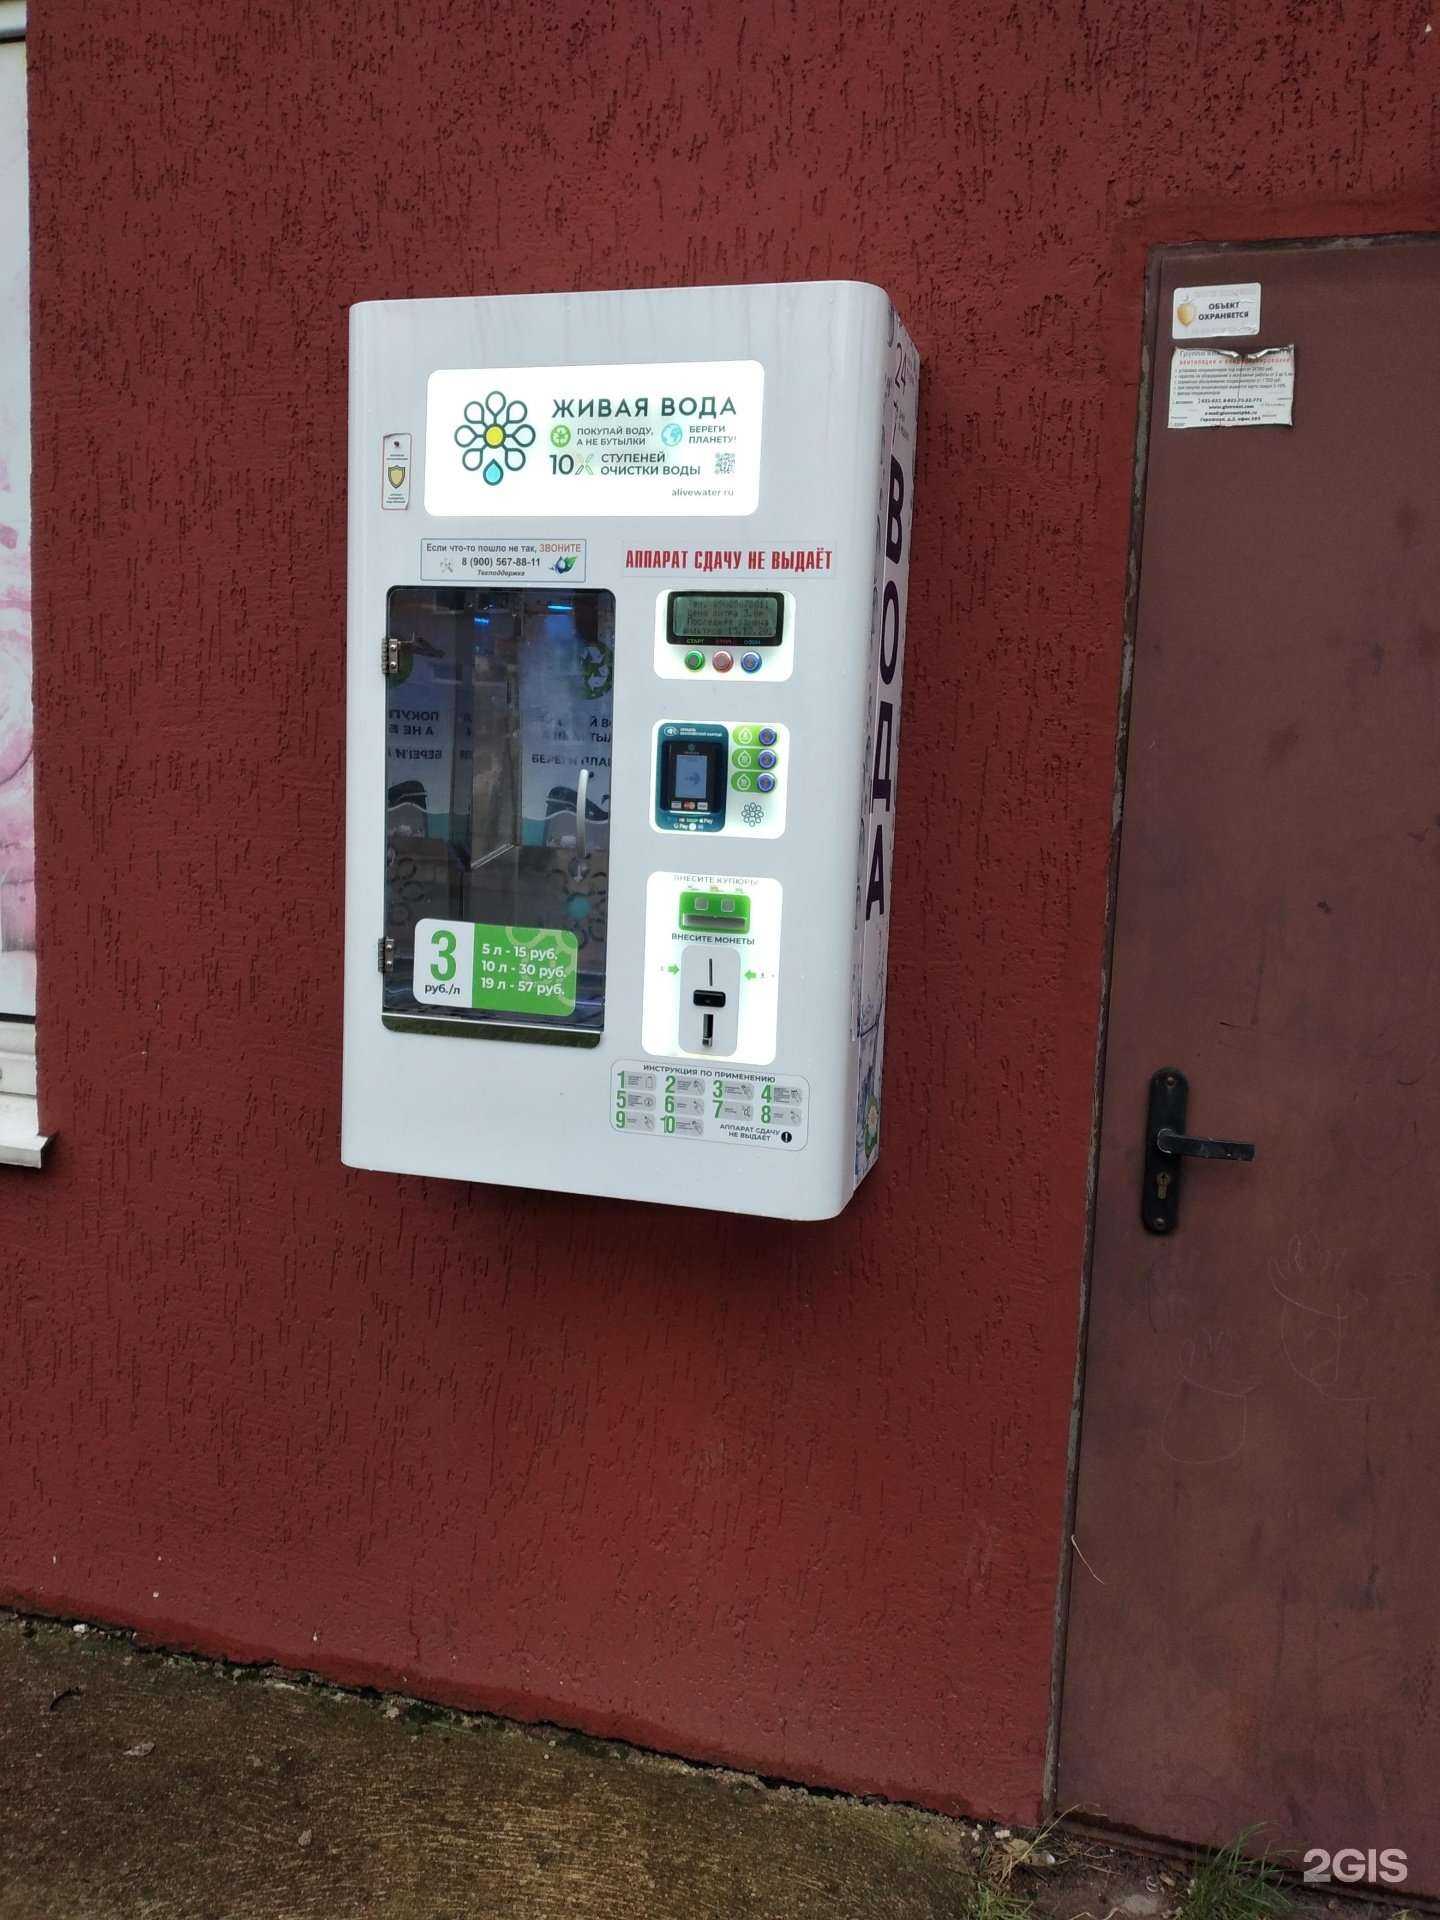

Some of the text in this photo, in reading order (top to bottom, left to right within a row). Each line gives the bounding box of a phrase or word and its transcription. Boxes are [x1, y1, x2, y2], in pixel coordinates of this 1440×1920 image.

[1208, 302, 1240, 310] ОБЪЕКТ
[1198, 312, 1249, 321] ОХРАНЯЕТСЯ
[551, 396, 737, 419] ЖИВАЯ ВОДА
[577, 425, 654, 437] ПОКУПАЙ ВОДУ,
[689, 425, 726, 434] БЕРЕГИ
[576, 437, 646, 446] А НЕ БУТЫЛКИ
[601, 450, 666, 463] СТУПЕНЕЙ
[600, 466, 701, 477] ОЧИСТКИ ВОДЫ
[671, 487, 735, 497] alivewater.ru
[426, 543, 581, 555] Если что-то пошло не так, ЗВОНИТЕ
[461, 557, 540, 568] 8 (900) 567-88-11
[625, 547, 833, 573] АППАРАТ СДАЧУ НЕ ВЫДАЁТ
[865, 454, 904, 921] ВОДА
[671, 933, 755, 945] ВНЕСИТЕ МОНЕТЫ
[430, 929, 457, 982] 3
[481, 943, 491, 955] 5
[492, 946, 502, 956] л
[513, 945, 527, 957] 15
[529, 948, 558, 961] руб.
[481, 960, 496, 972] 10
[498, 963, 508, 973] л
[519, 963, 536, 975] 30
[539, 965, 567, 979] руб.
[424, 983, 461, 996] руб./л
[480, 977, 495, 989] 19
[496, 980, 506, 990] л
[518, 980, 533, 992] 57
[536, 982, 565, 997] руб.
[617, 1070, 625, 1089] 1
[642, 1064, 776, 1083] ИНСТРУКЦИЯ ПО ПРИМЕНЕНИЮ
[665, 1075, 676, 1093] 2
[712, 1080, 723, 1098] 3
[616, 1090, 626, 1109] 5
[761, 1085, 773, 1103] 4
[665, 1096, 675, 1113] 6
[712, 1100, 723, 1119] 7
[615, 1110, 626, 1129] 9
[761, 1105, 772, 1124] 8
[660, 1115, 676, 1133] 10
[719, 1123, 781, 1136] АППАРАТ СДАЧУ
[728, 1131, 741, 1139] НЕ
